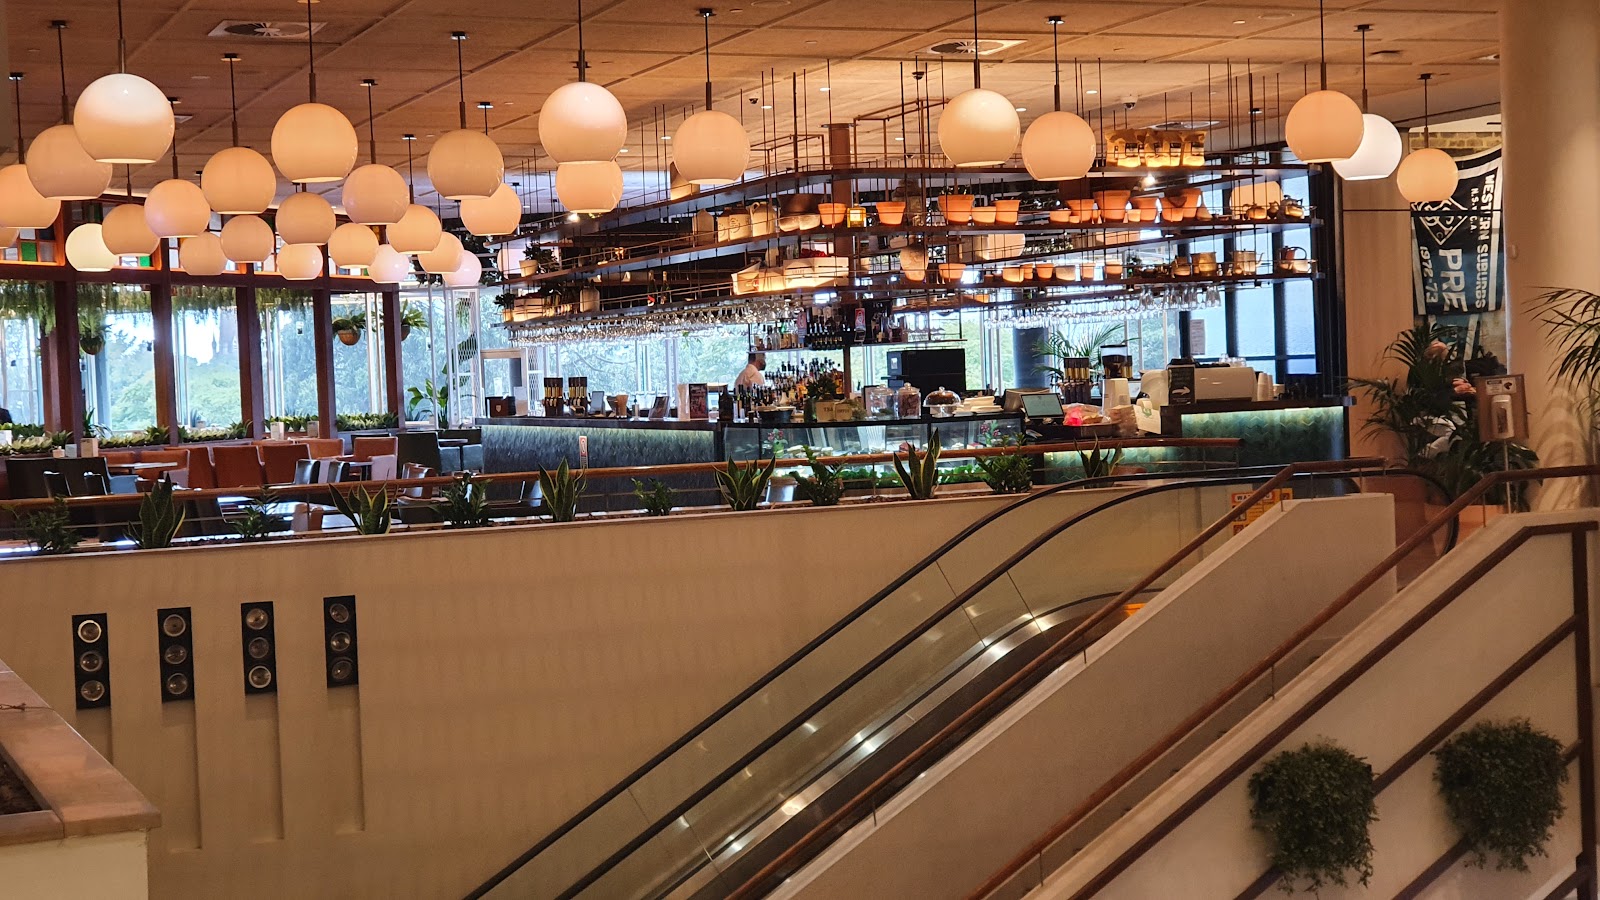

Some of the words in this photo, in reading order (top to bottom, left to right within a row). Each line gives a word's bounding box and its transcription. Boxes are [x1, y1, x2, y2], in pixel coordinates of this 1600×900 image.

[1477, 174, 1496, 240] WESTERN
[1419, 246, 1440, 304] 1972-73
[1438, 248, 1469, 312] PRE
[1474, 243, 1489, 308] SUBURBS
